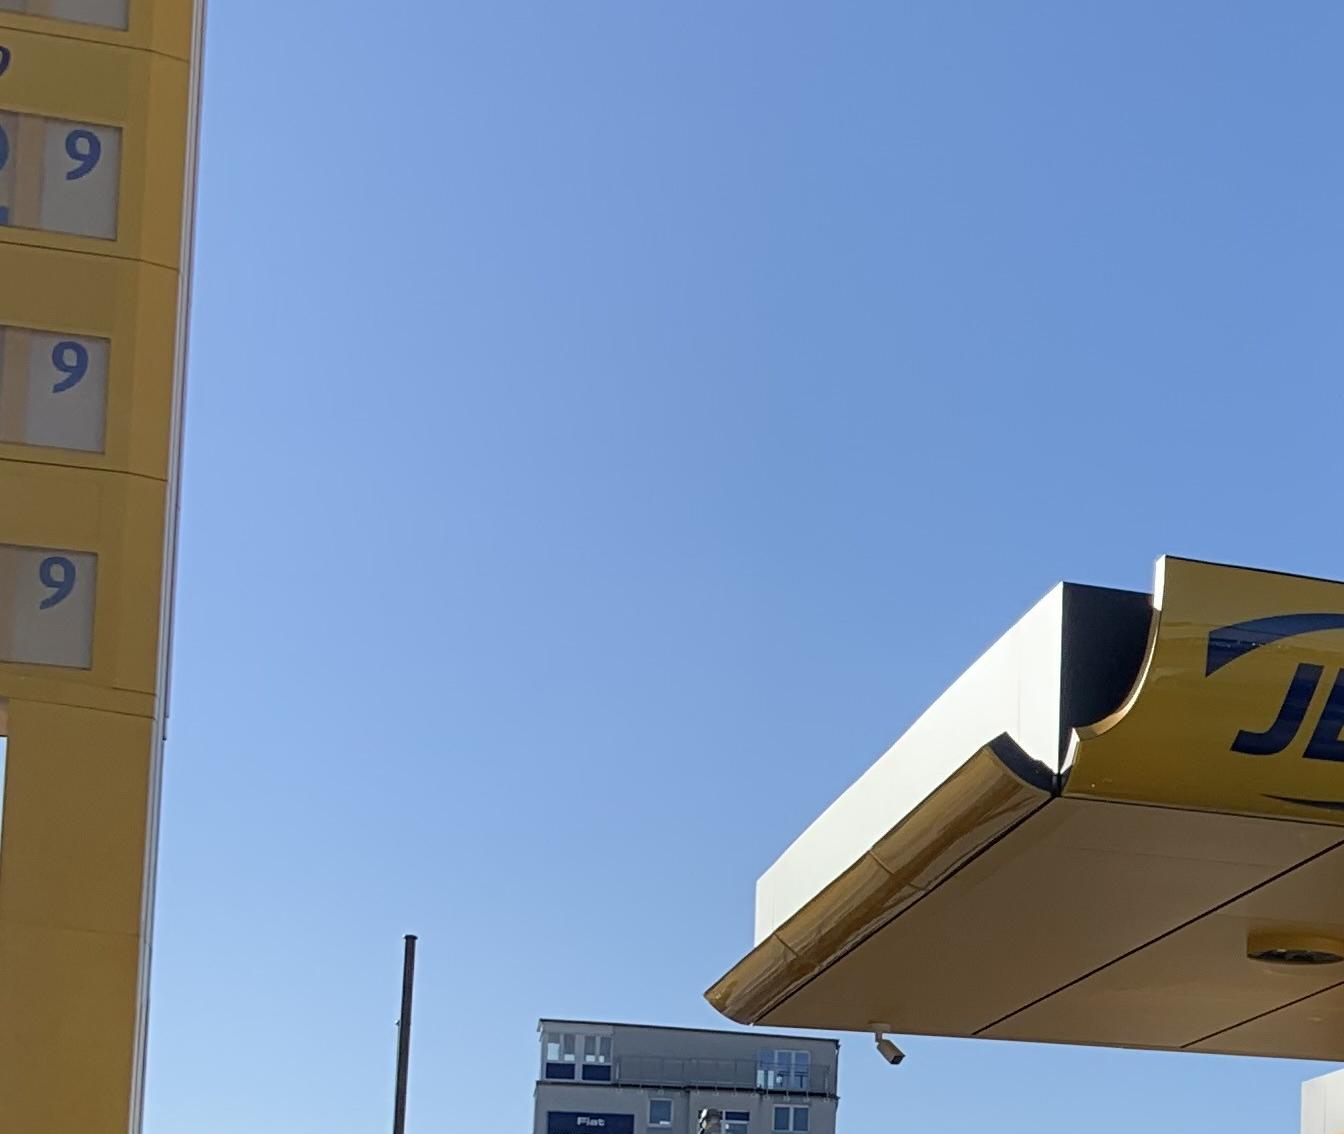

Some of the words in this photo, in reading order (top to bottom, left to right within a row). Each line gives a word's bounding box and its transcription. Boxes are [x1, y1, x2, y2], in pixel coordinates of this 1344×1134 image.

[65, 129, 101, 180] 9
[52, 341, 89, 394] 9
[39, 556, 76, 610] 9
[577, 1116, 606, 1127] Fiat
